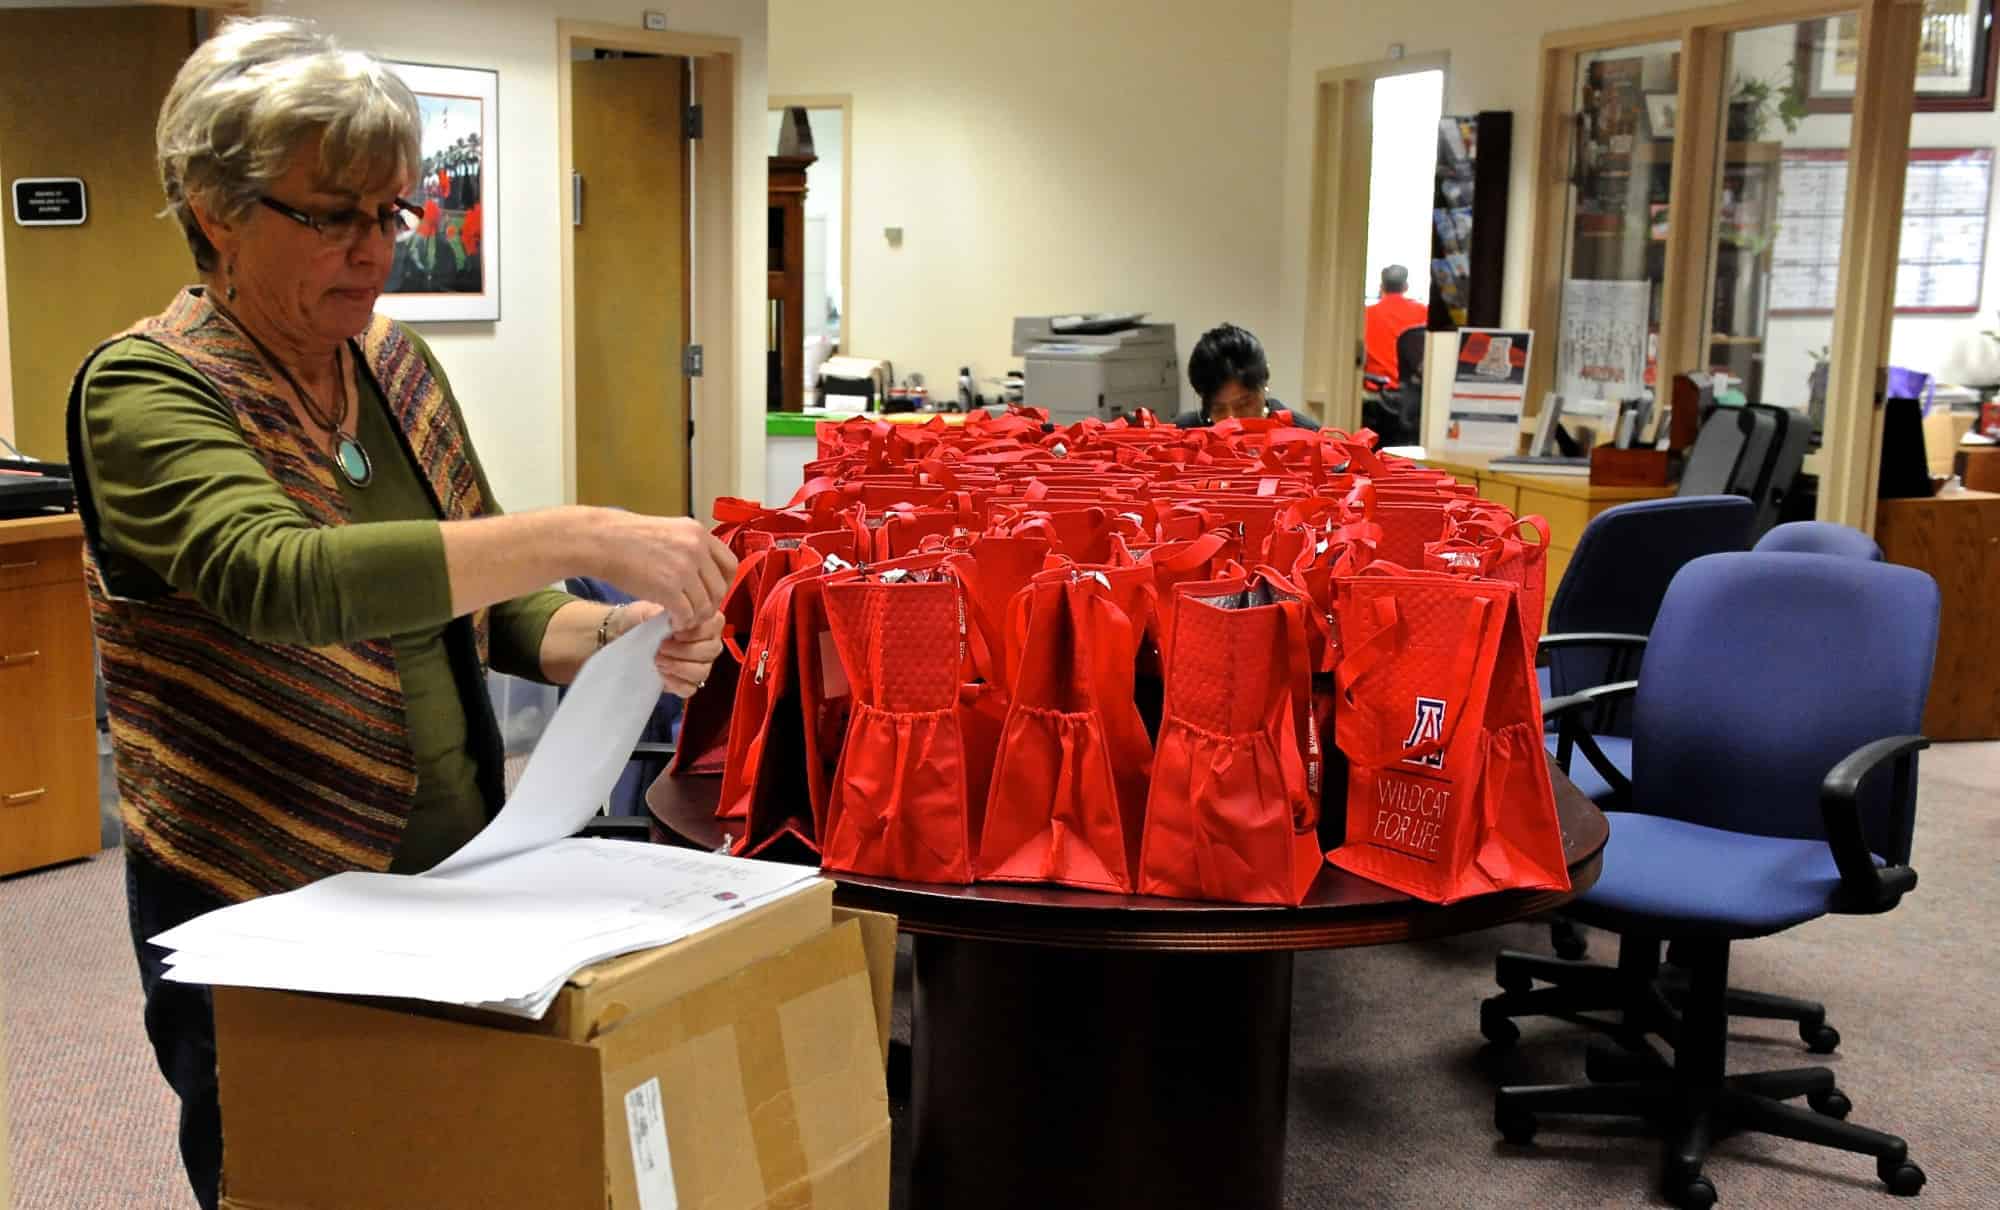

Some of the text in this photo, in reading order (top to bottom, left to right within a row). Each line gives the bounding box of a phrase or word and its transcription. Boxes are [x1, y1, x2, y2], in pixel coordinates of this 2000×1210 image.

[1402, 696, 1447, 770] A
[1377, 776, 1451, 818] WILDCAT
[1374, 810, 1441, 853] FOR LIFE
